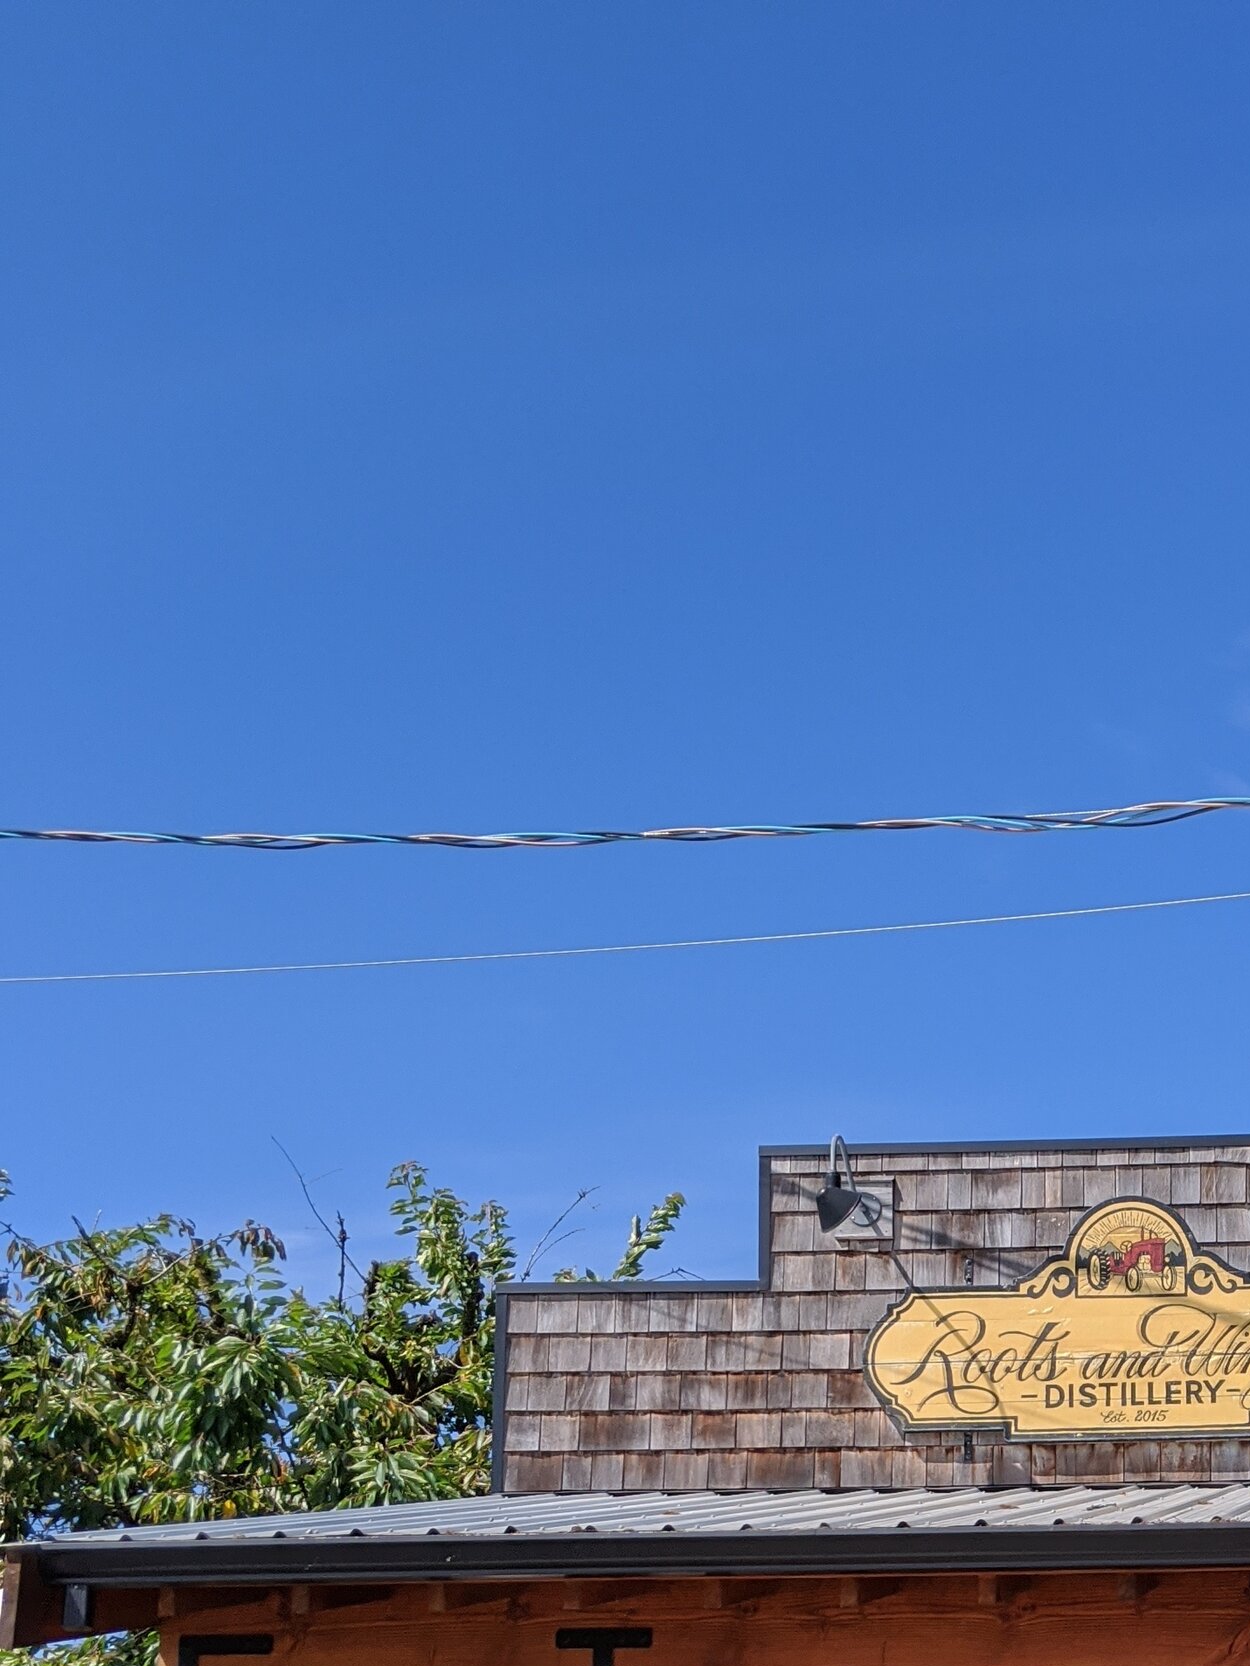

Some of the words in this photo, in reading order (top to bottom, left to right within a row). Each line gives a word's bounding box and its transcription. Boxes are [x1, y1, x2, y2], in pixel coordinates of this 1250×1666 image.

[890, 1310, 1070, 1414] Roots
[1081, 1330, 1171, 1380] and
[1100, 1409, 1130, 1423] Est.
[1134, 1409, 1169, 1422] 2015
